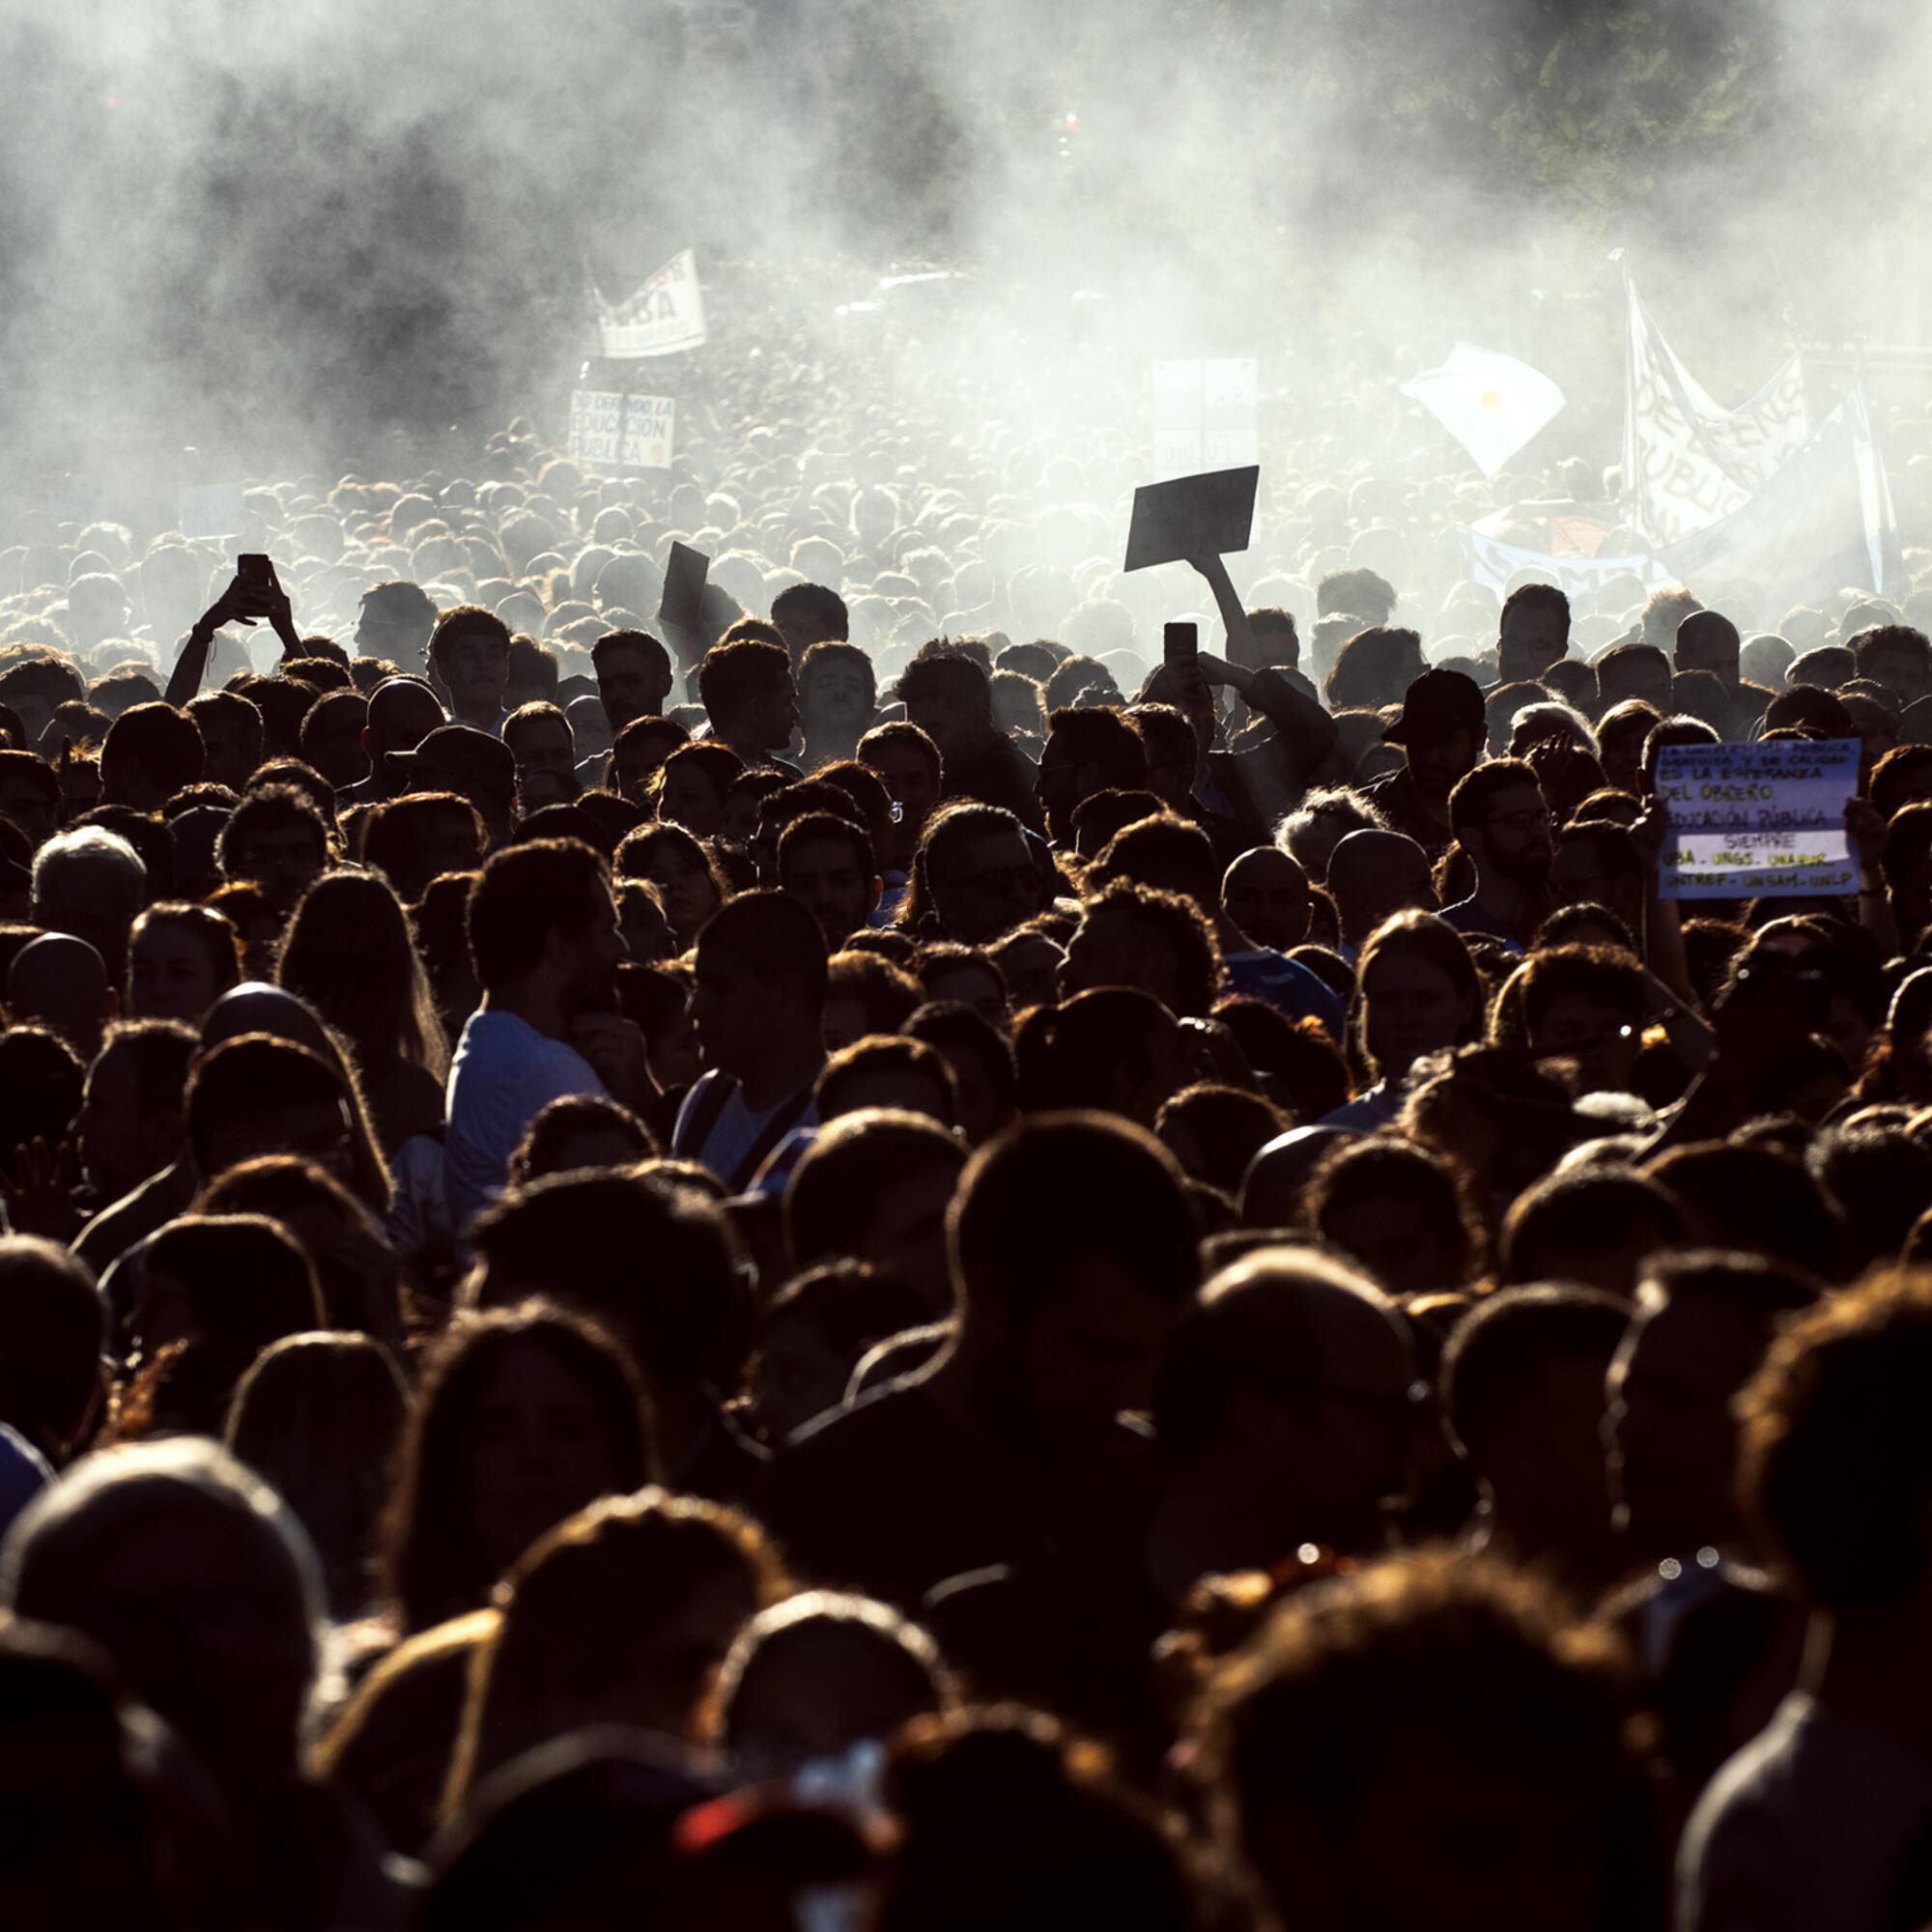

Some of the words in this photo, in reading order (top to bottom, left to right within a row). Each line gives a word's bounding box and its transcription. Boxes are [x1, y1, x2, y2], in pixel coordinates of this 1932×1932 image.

[1660, 768, 1683, 781] ES
[1691, 767, 1713, 781] LA
[1720, 767, 1824, 781] ESPERANZA
[1660, 782, 1692, 802] DEL
[1662, 850, 1696, 866] UBA
